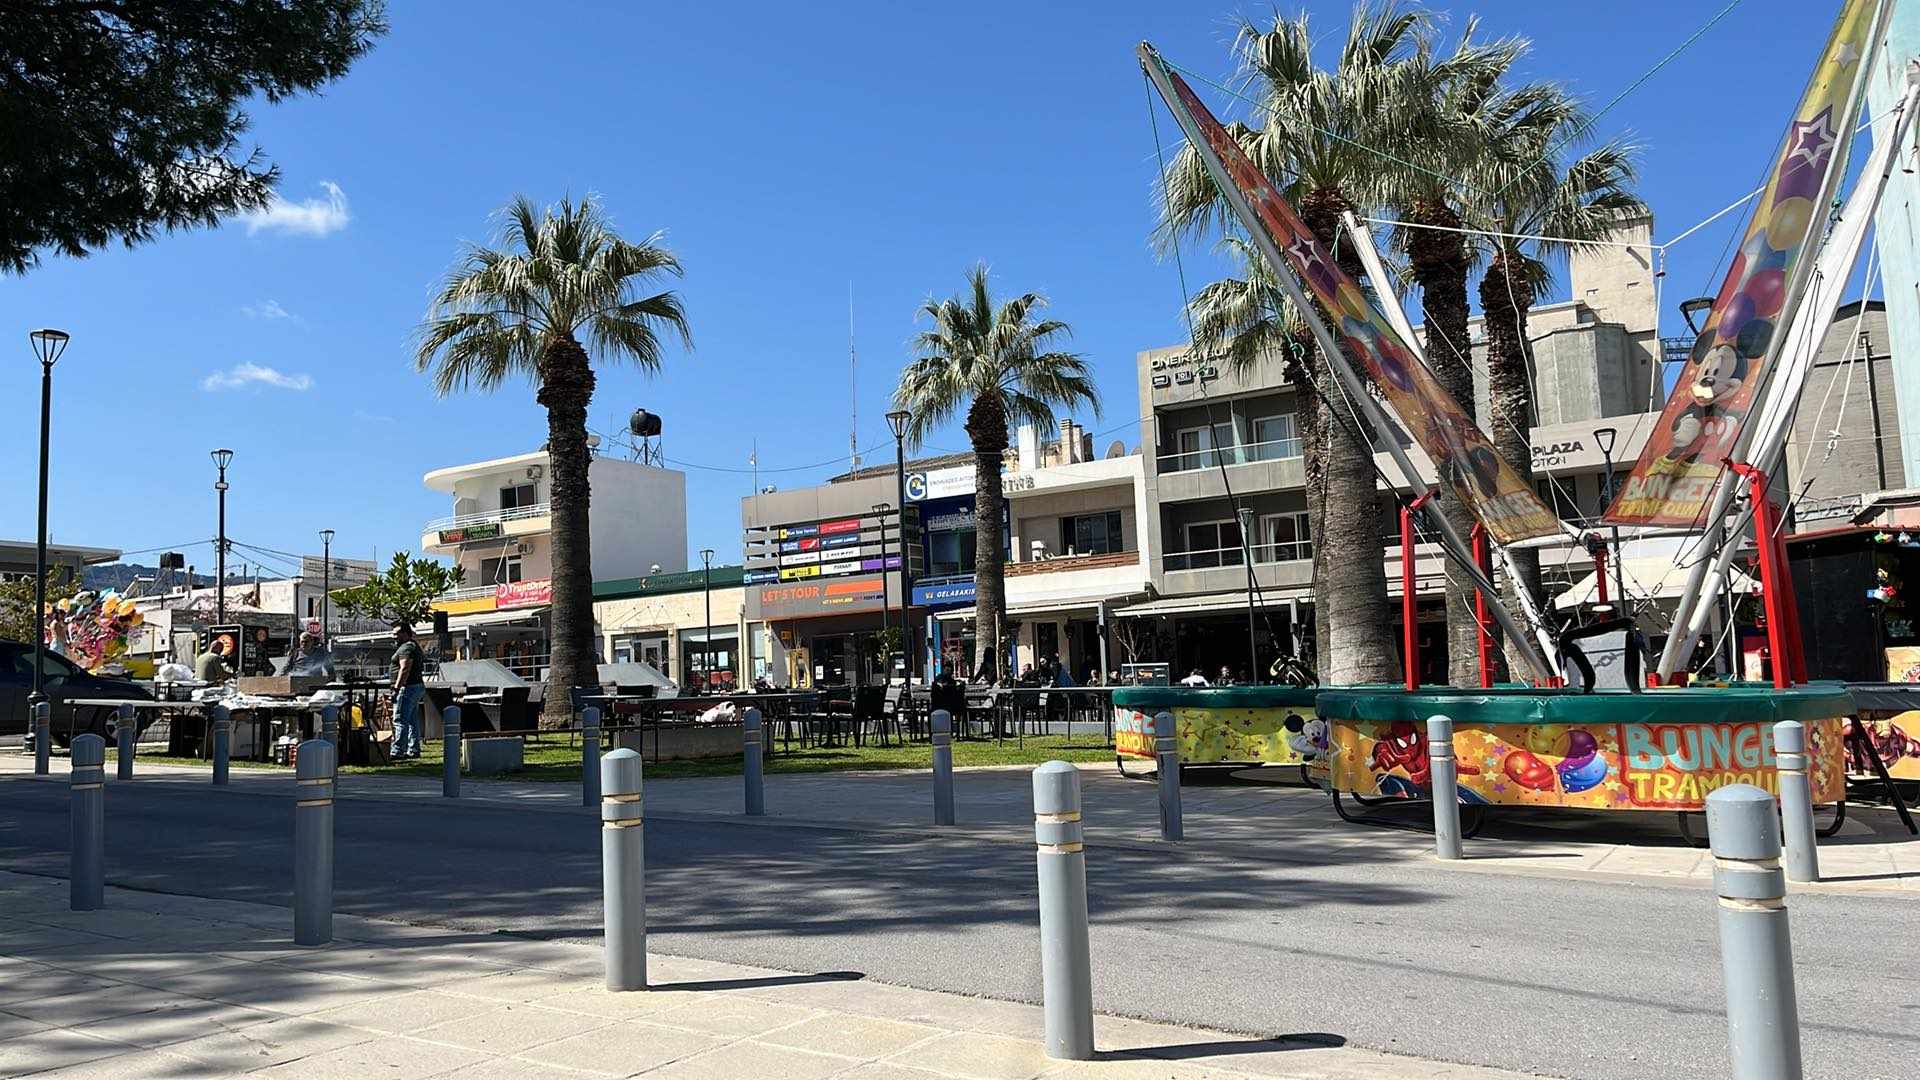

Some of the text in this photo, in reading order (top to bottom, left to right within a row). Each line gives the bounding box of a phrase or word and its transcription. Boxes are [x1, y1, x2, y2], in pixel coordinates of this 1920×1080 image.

[1531, 441, 1584, 457] PLAZA
[791, 586, 820, 600] TOUR
[1625, 725, 1777, 770] BUNGE
